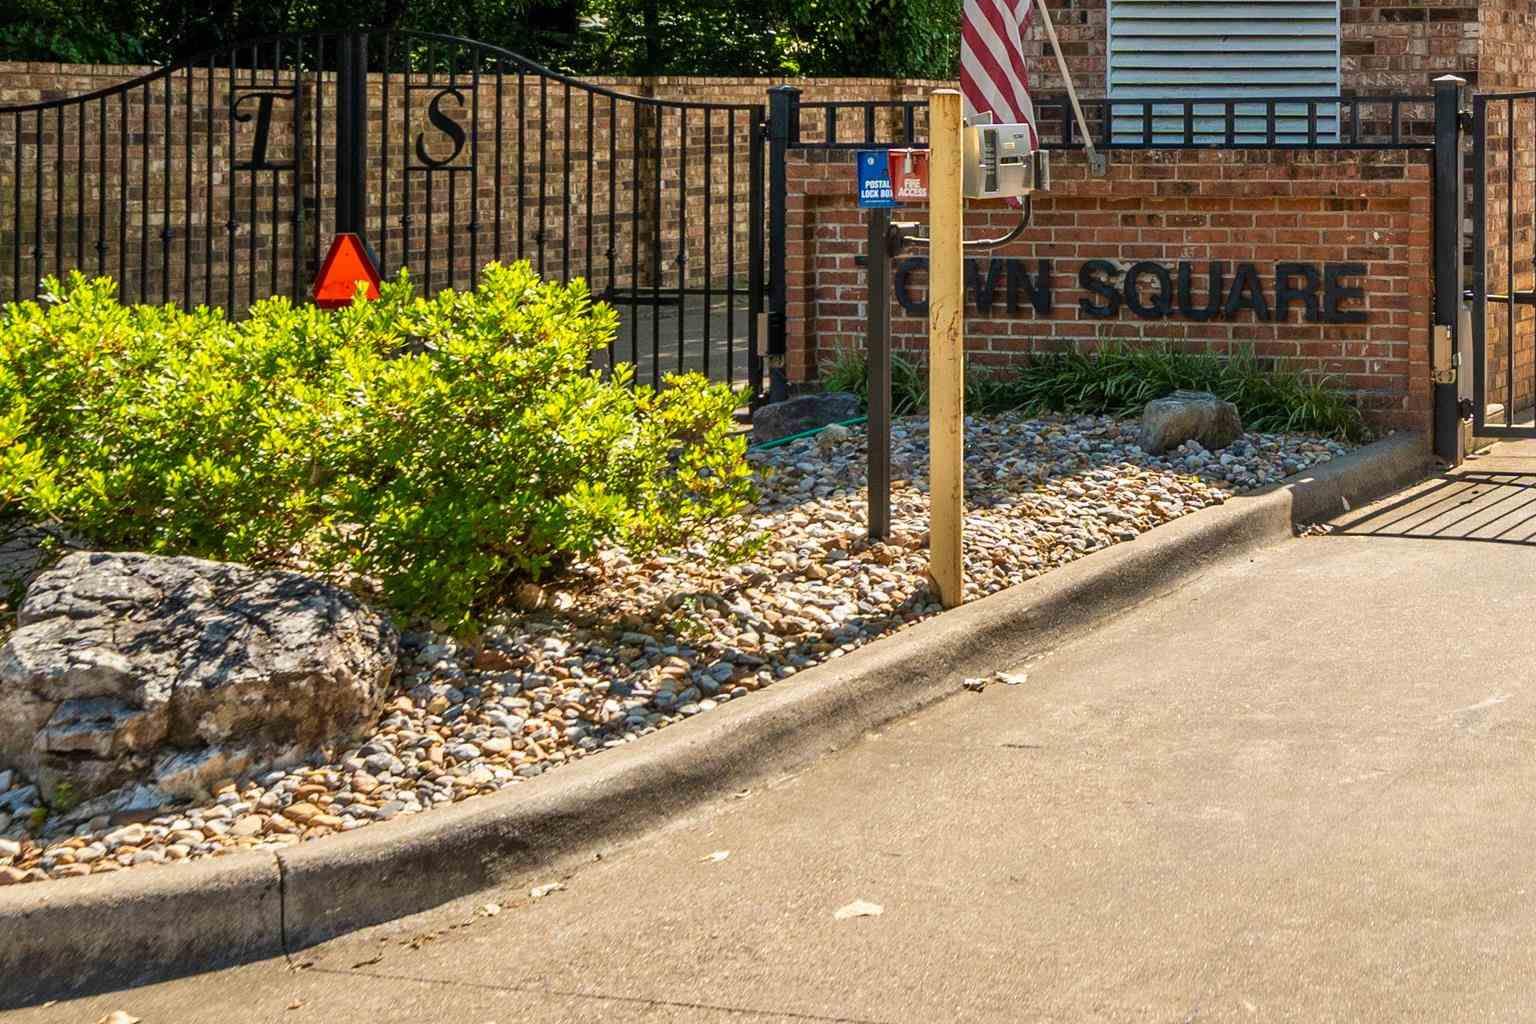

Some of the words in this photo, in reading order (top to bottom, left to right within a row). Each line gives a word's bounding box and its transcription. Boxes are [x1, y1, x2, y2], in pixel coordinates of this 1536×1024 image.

[864, 179, 890, 189] POSTAL
[861, 189, 879, 198] LOCK
[897, 187, 927, 197] ACCESS
[1078, 259, 1367, 324] SQUARE
